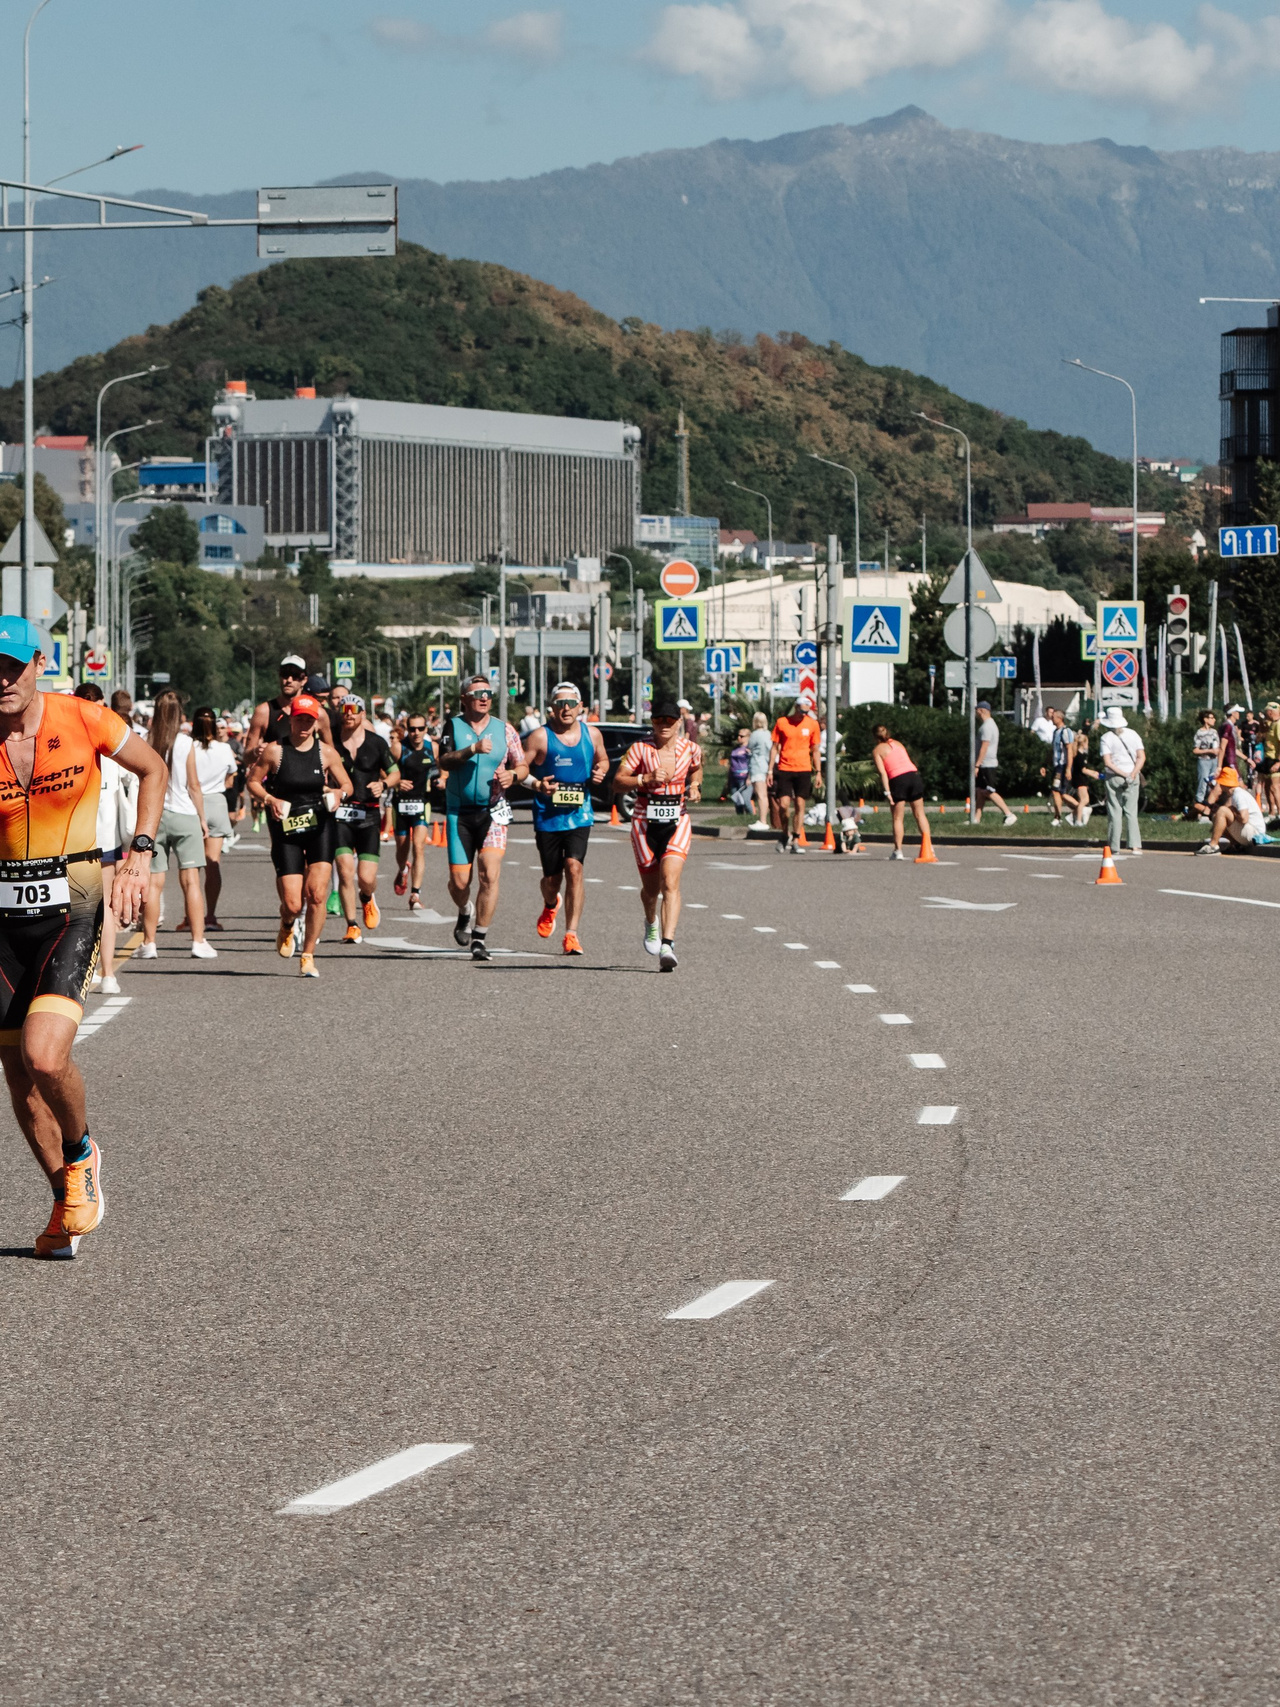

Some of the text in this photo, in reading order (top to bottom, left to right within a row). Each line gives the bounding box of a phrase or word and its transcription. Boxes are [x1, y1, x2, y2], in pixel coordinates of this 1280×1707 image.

[559, 793, 580, 802] 1654
[343, 809, 359, 818] 749
[653, 808, 676, 817] 1033
[122, 868, 140, 877] 703
[12, 883, 52, 905] 703
[26, 908, 41, 916] ПЕТР
[84, 1167, 97, 1203] HOKA
